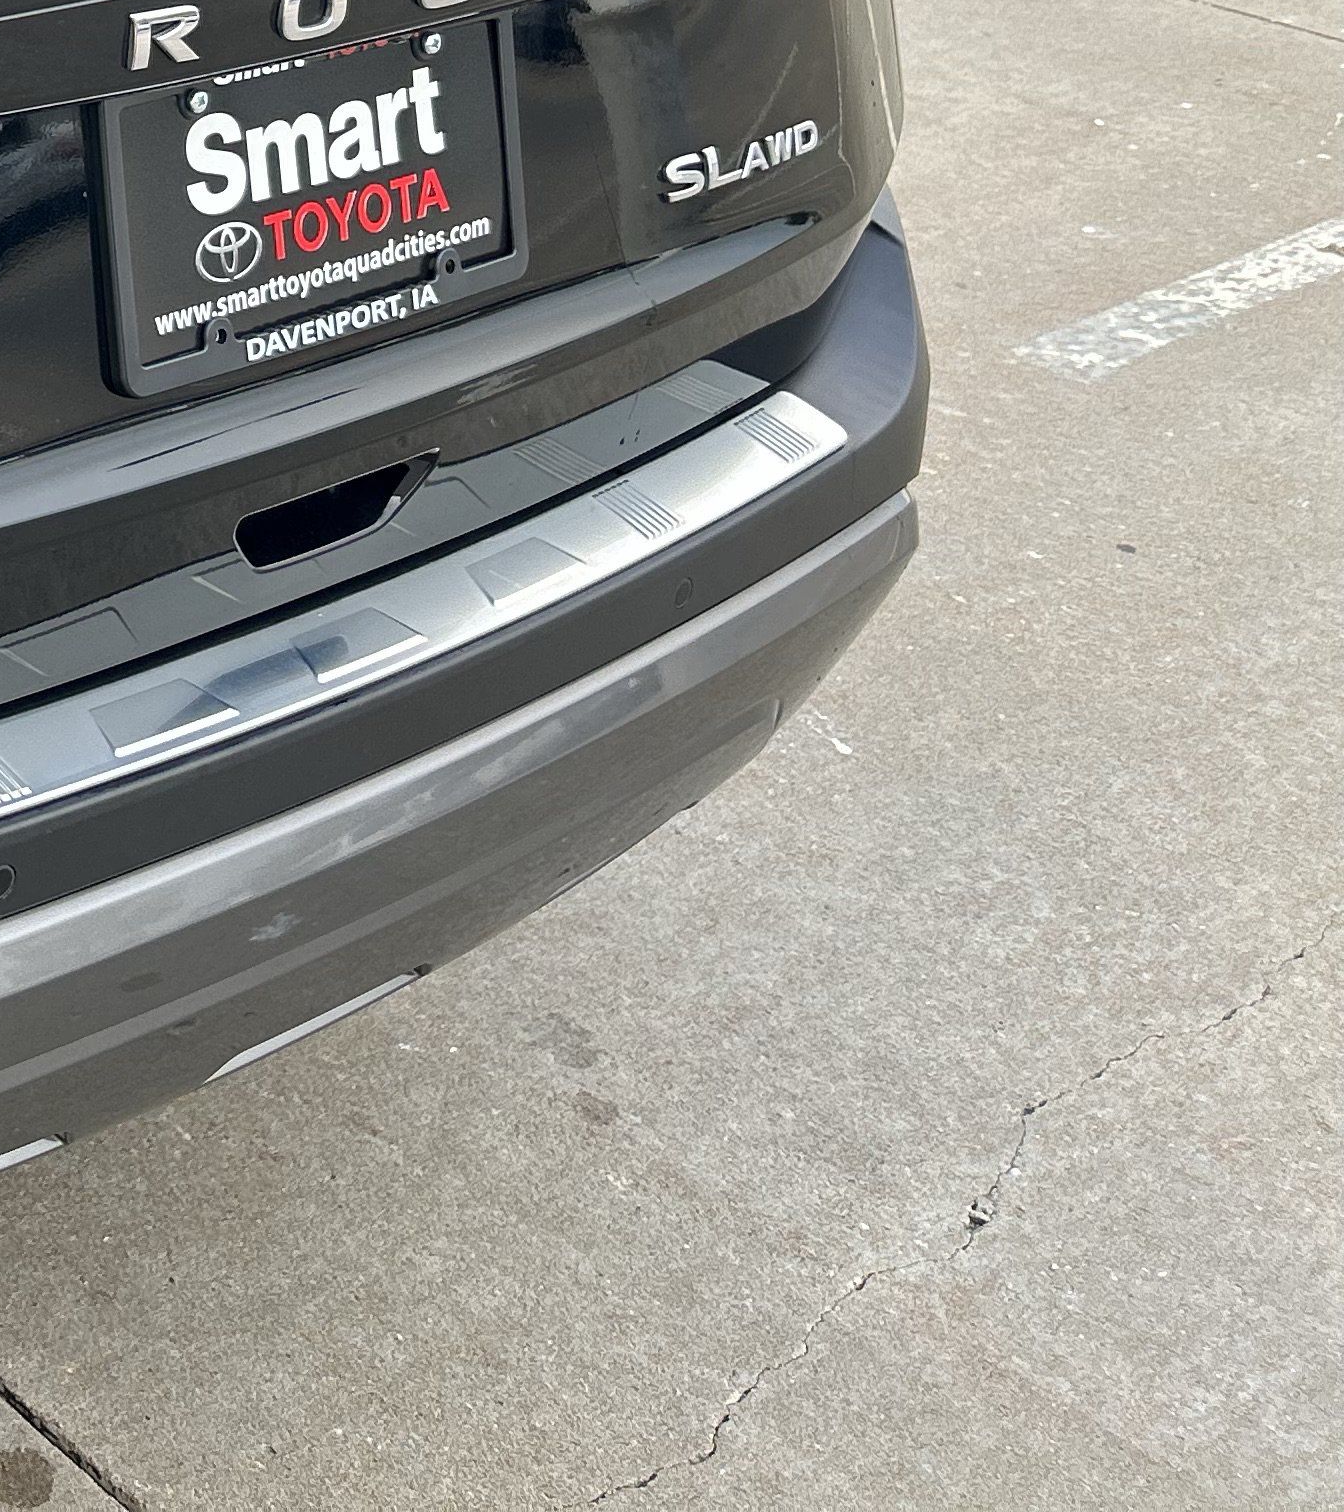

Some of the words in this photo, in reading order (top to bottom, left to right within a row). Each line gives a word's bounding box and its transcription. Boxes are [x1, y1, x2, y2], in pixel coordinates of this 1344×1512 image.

[185, 66, 446, 215] Smart
[263, 168, 451, 261] TOYOTA
[154, 216, 492, 337] www.smarttoyotaquadcities.com
[245, 291, 408, 363] DAVENPORT,
[411, 283, 440, 311] IA
